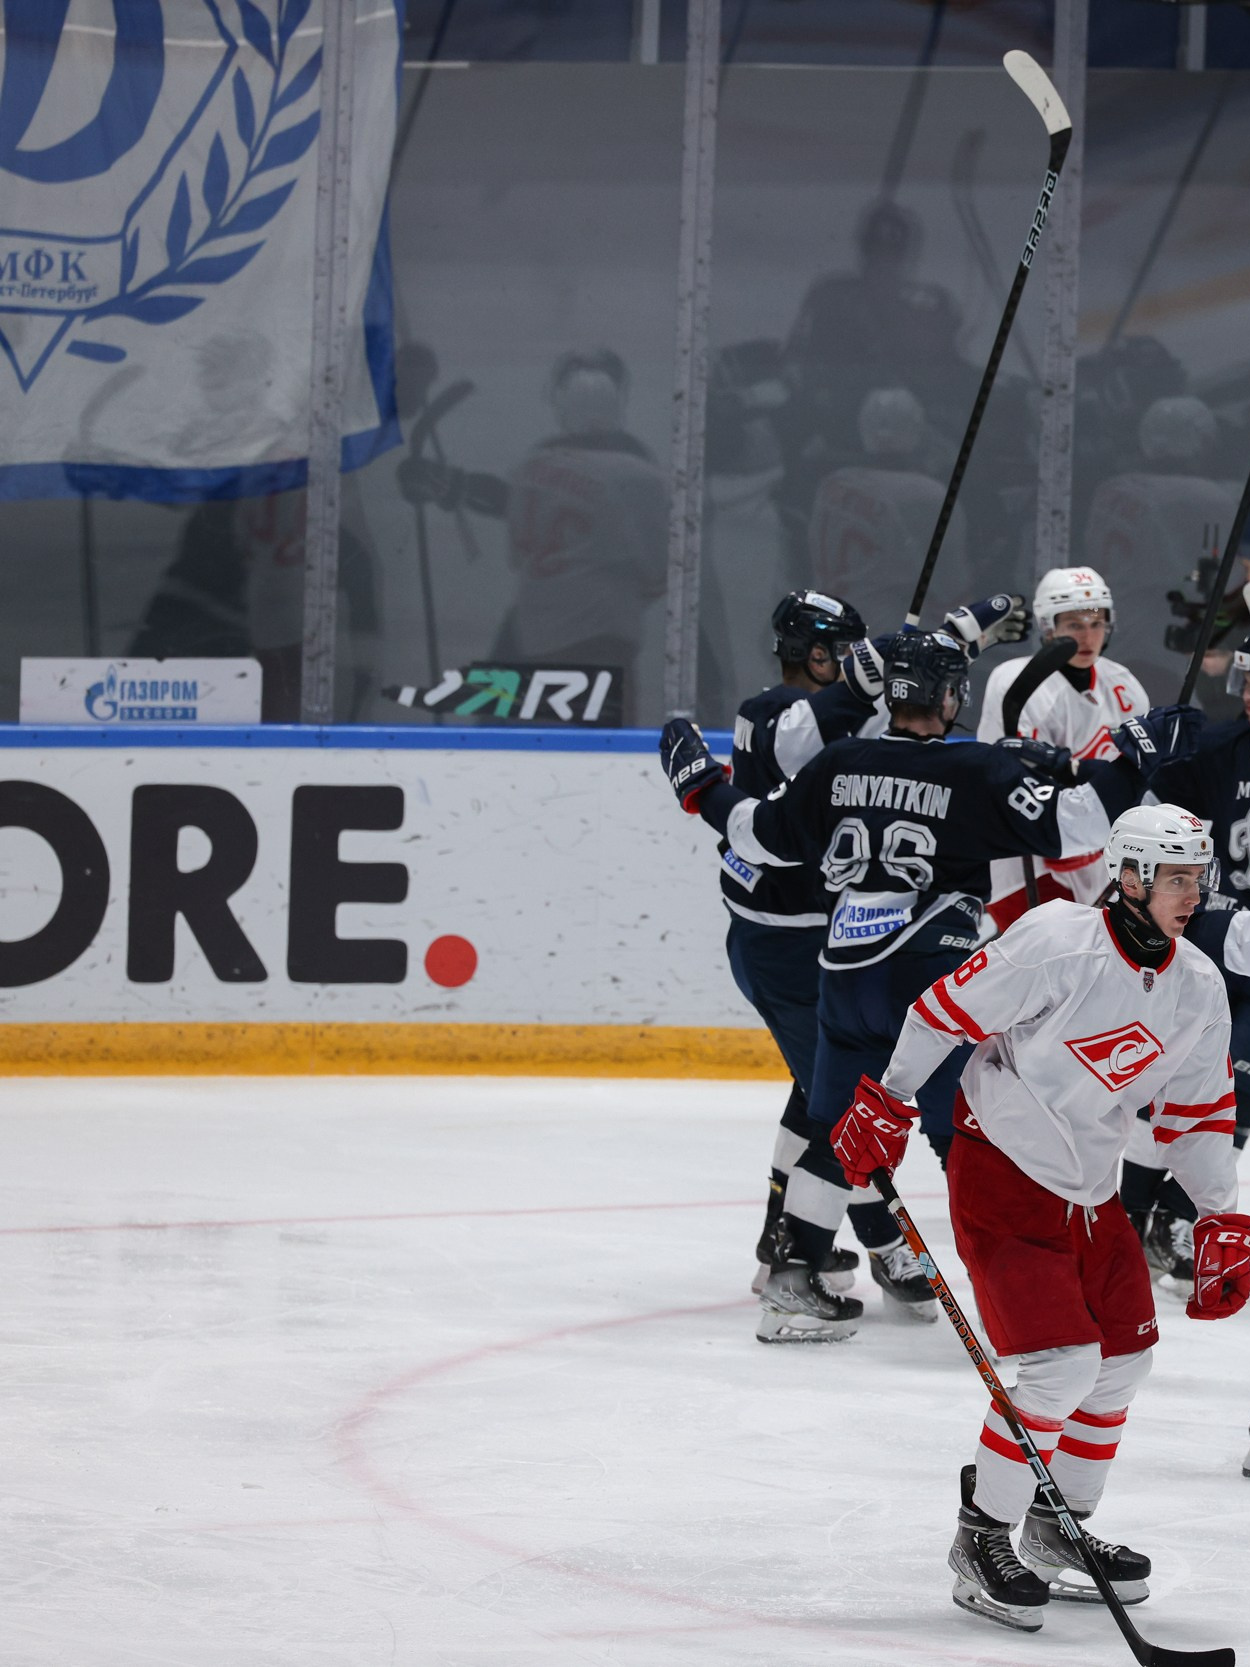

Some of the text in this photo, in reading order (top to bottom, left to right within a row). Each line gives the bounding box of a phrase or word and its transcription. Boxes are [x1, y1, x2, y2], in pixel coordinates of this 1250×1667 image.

[120, 680, 198, 701] ГАЗПРОМ
[891, 681, 909, 699] 86
[1113, 685, 1133, 713] C
[831, 774, 952, 820] SINYATKIN
[1123, 844, 1144, 853] CCM
